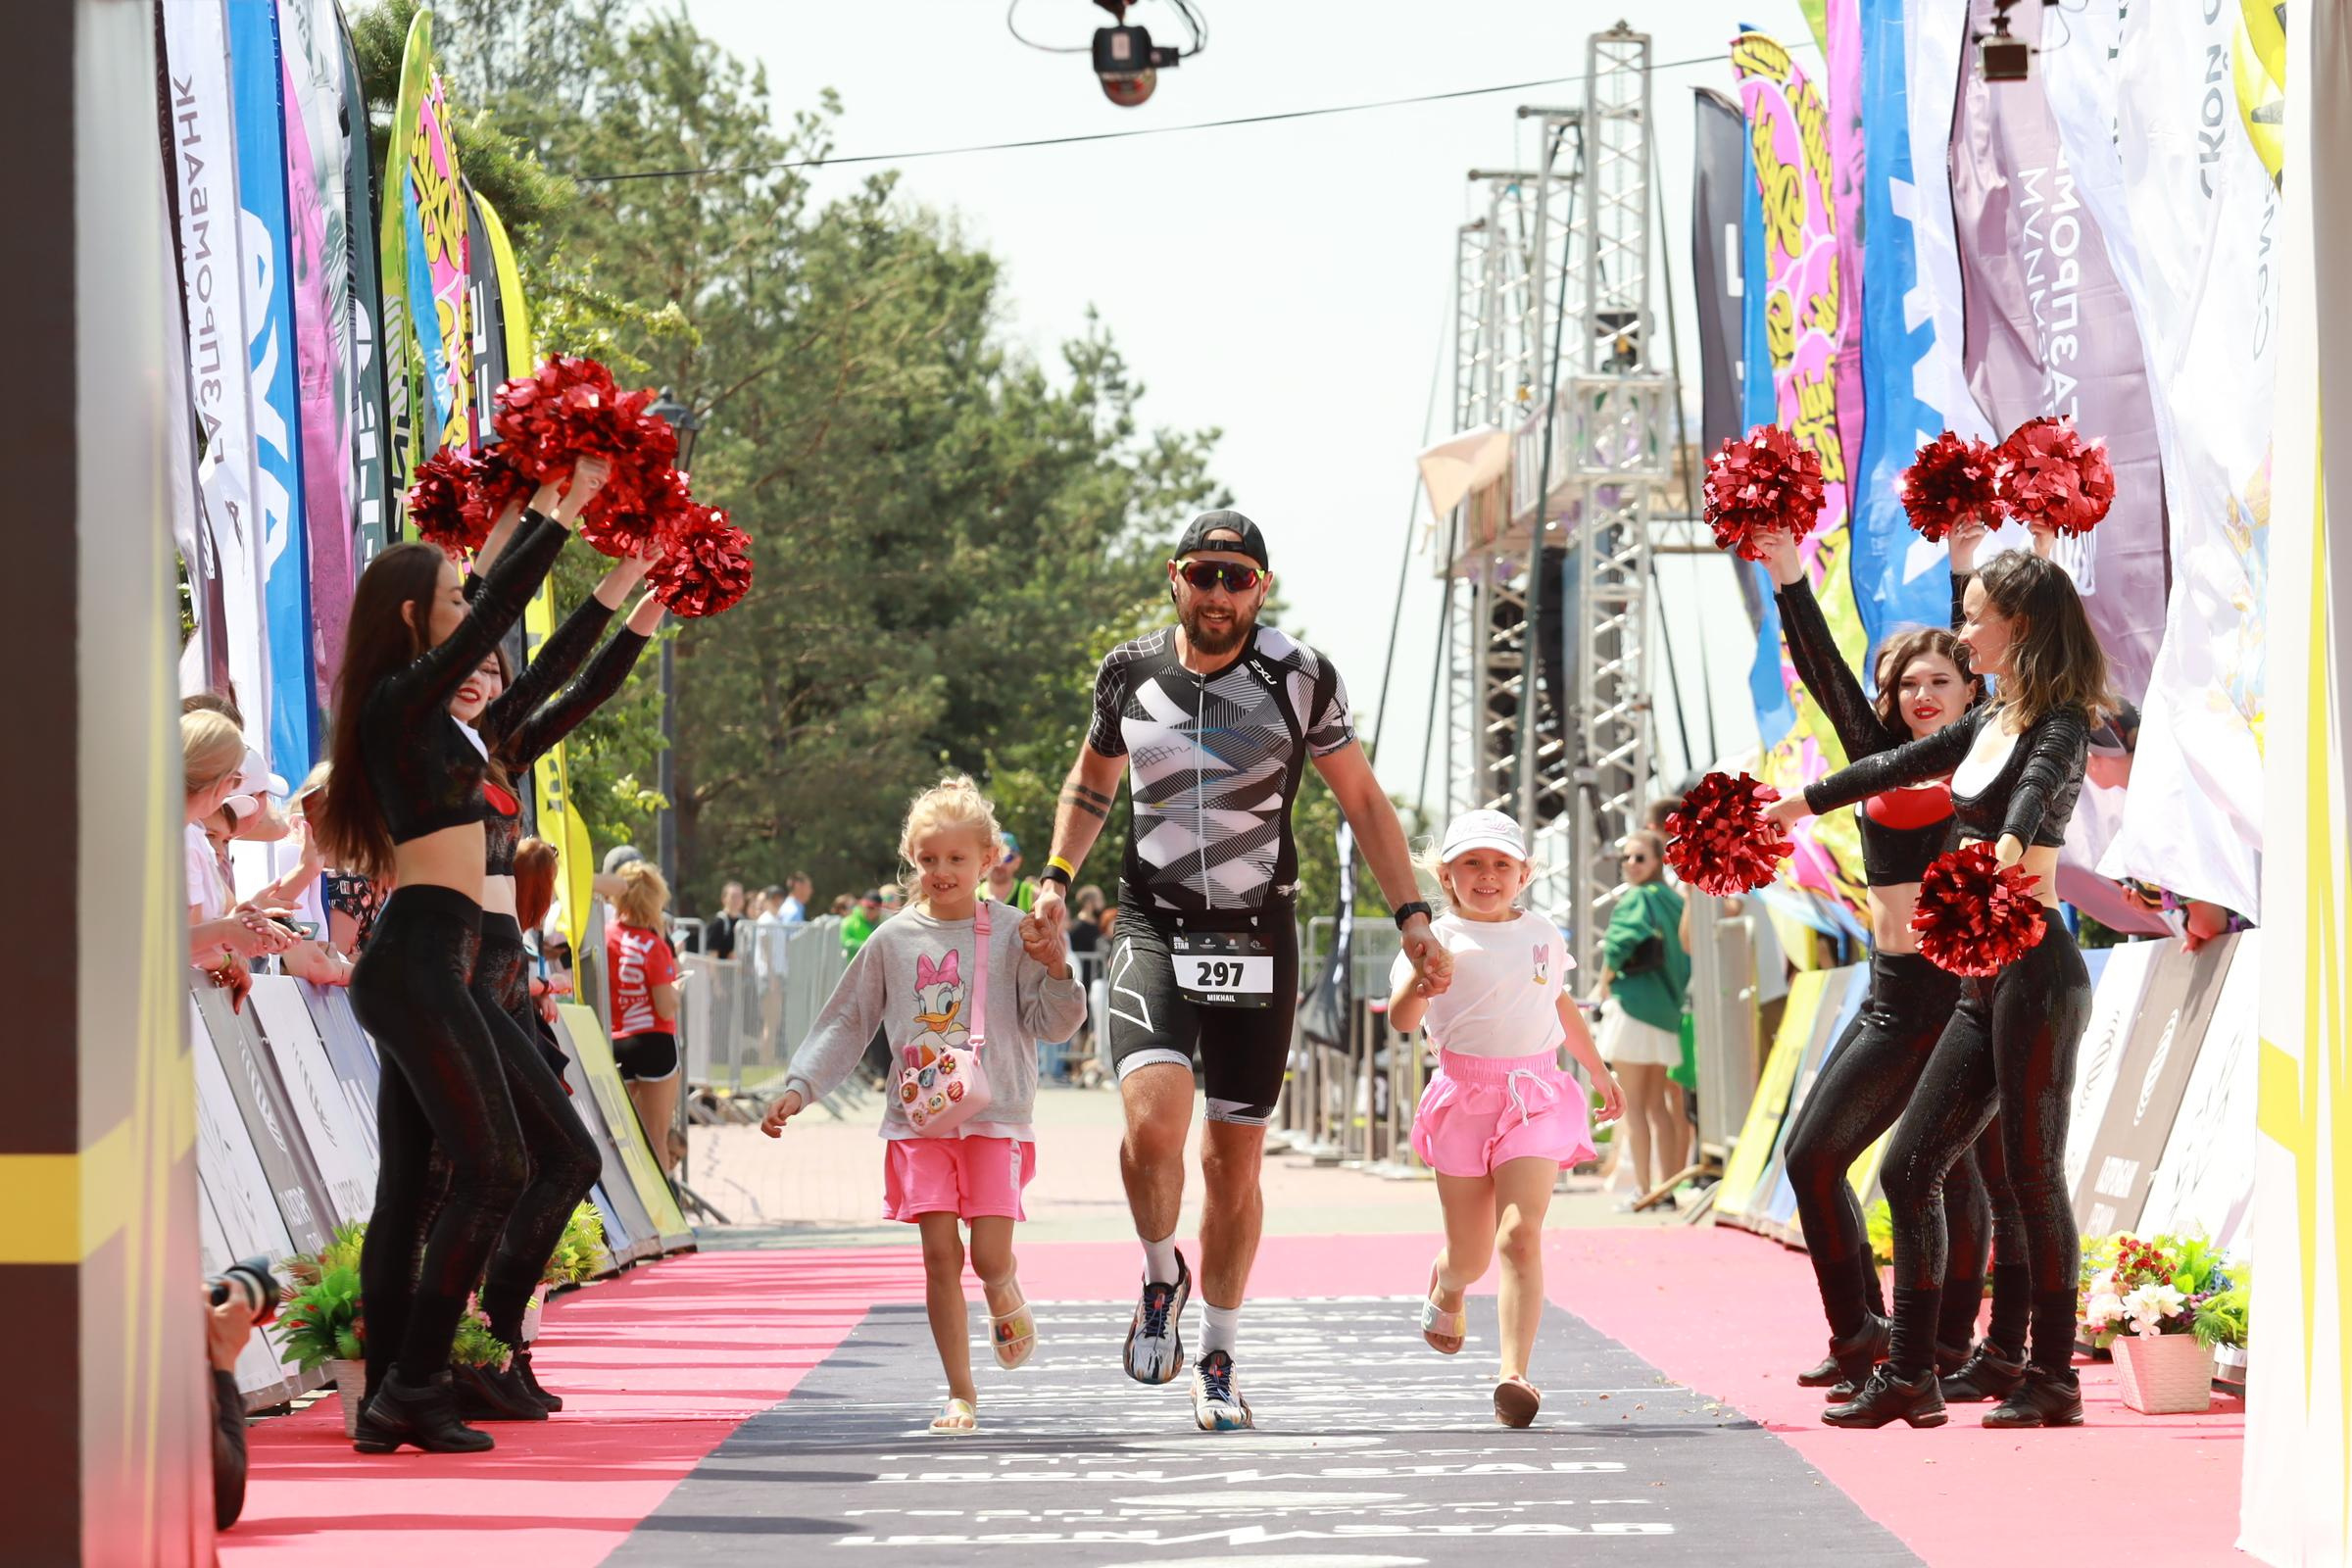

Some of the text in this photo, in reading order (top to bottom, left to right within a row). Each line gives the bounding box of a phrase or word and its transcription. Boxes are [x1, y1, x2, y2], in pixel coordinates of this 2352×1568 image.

[1250, 659, 1278, 685] 2XU
[1173, 942, 1190, 951] STAR
[618, 931, 655, 996] LOVE
[1197, 961, 1245, 987] 297
[1206, 994, 1236, 1003] MIKHAIL
[876, 1462, 1627, 1481] IRON STAR
[836, 1522, 1676, 1544] IRON STAR
